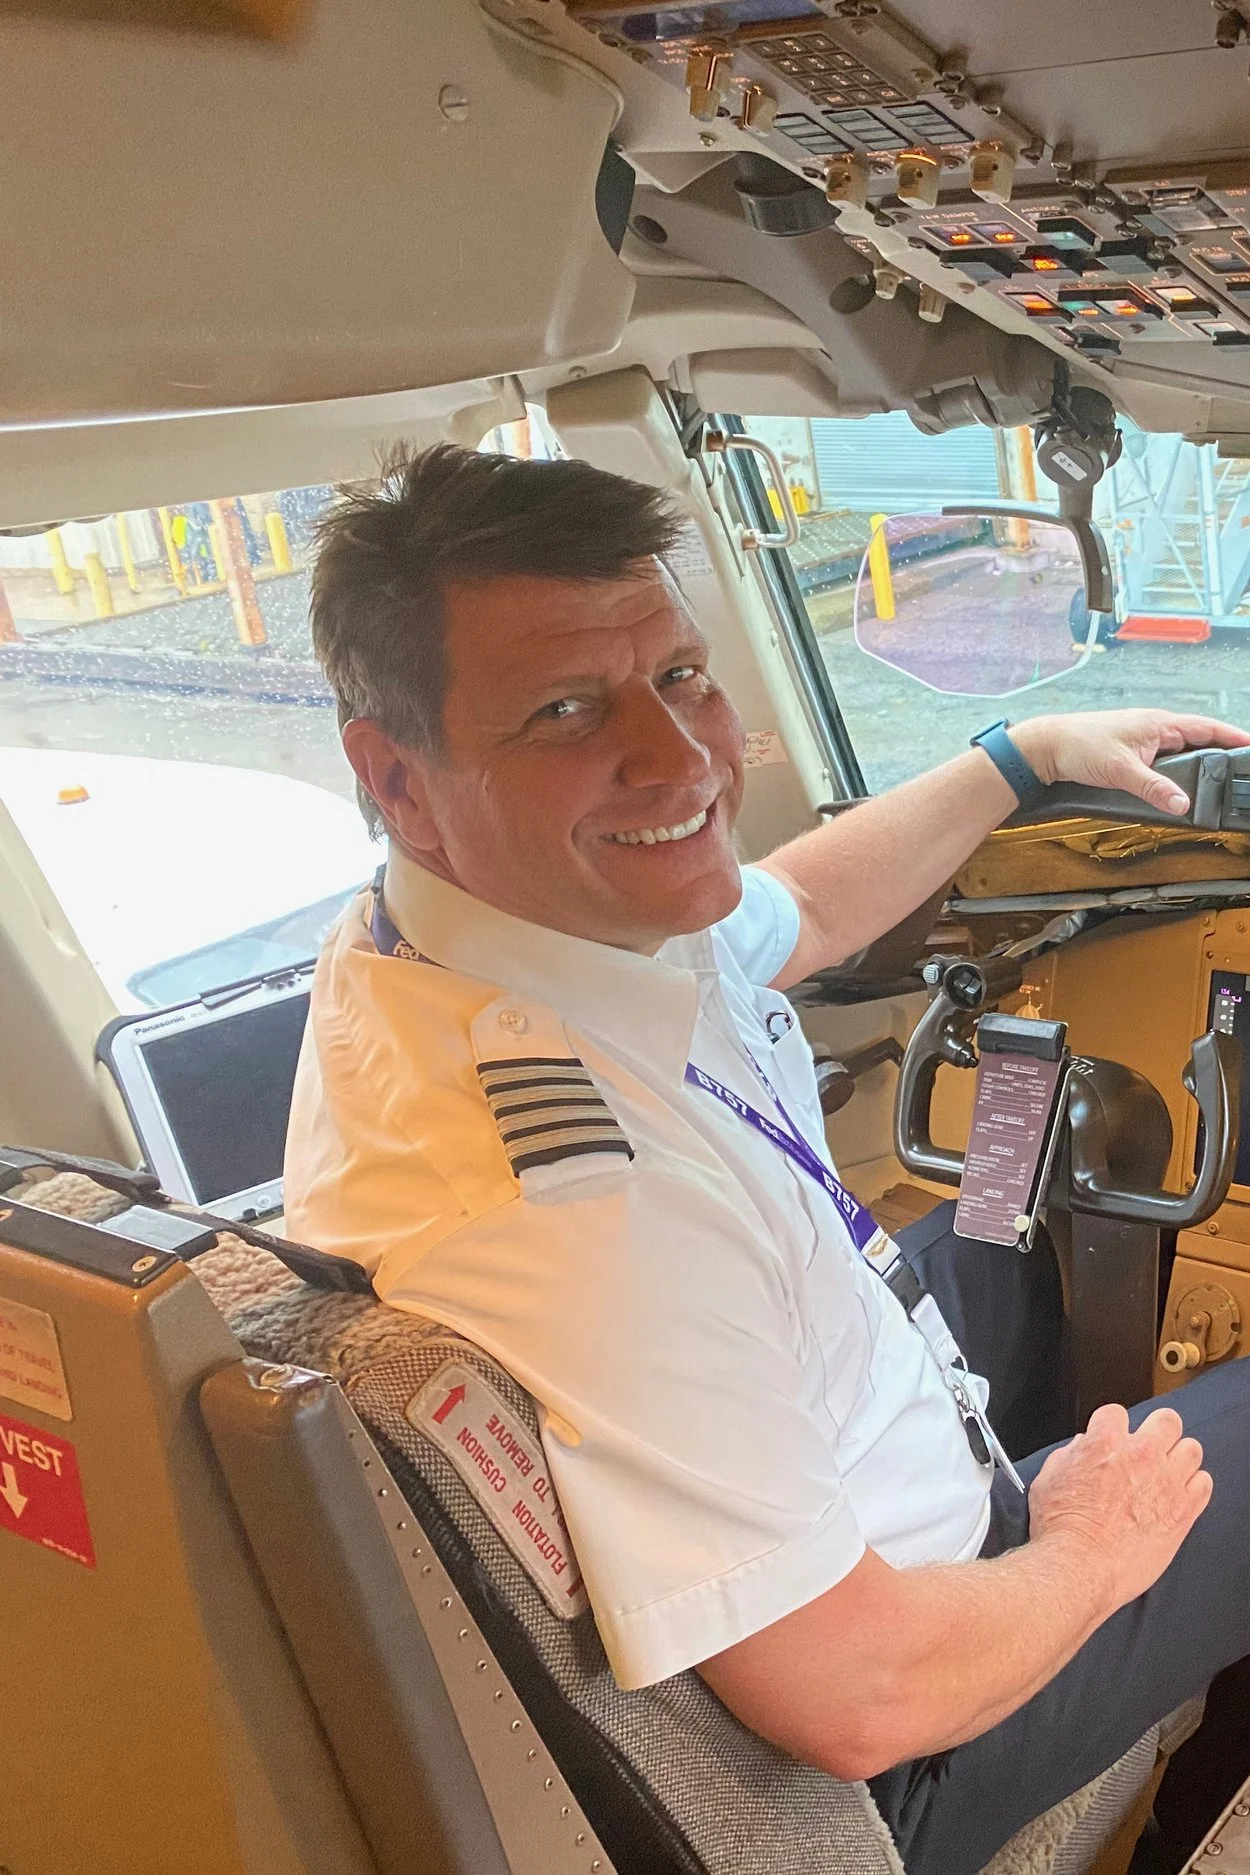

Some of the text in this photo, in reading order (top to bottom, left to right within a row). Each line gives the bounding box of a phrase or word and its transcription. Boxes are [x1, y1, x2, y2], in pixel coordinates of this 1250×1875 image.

[694, 1069, 748, 1116] B757
[1017, 1065, 1039, 1073] TAKEOFF
[989, 1144, 1015, 1153] APPROACH
[822, 1170, 859, 1221] B757
[982, 1187, 1004, 1197] LANDING
[0, 1425, 63, 1477] VEST
[485, 1413, 550, 1502] TO REMOVE
[456, 1426, 568, 1576] FLOTATION CUSHION
